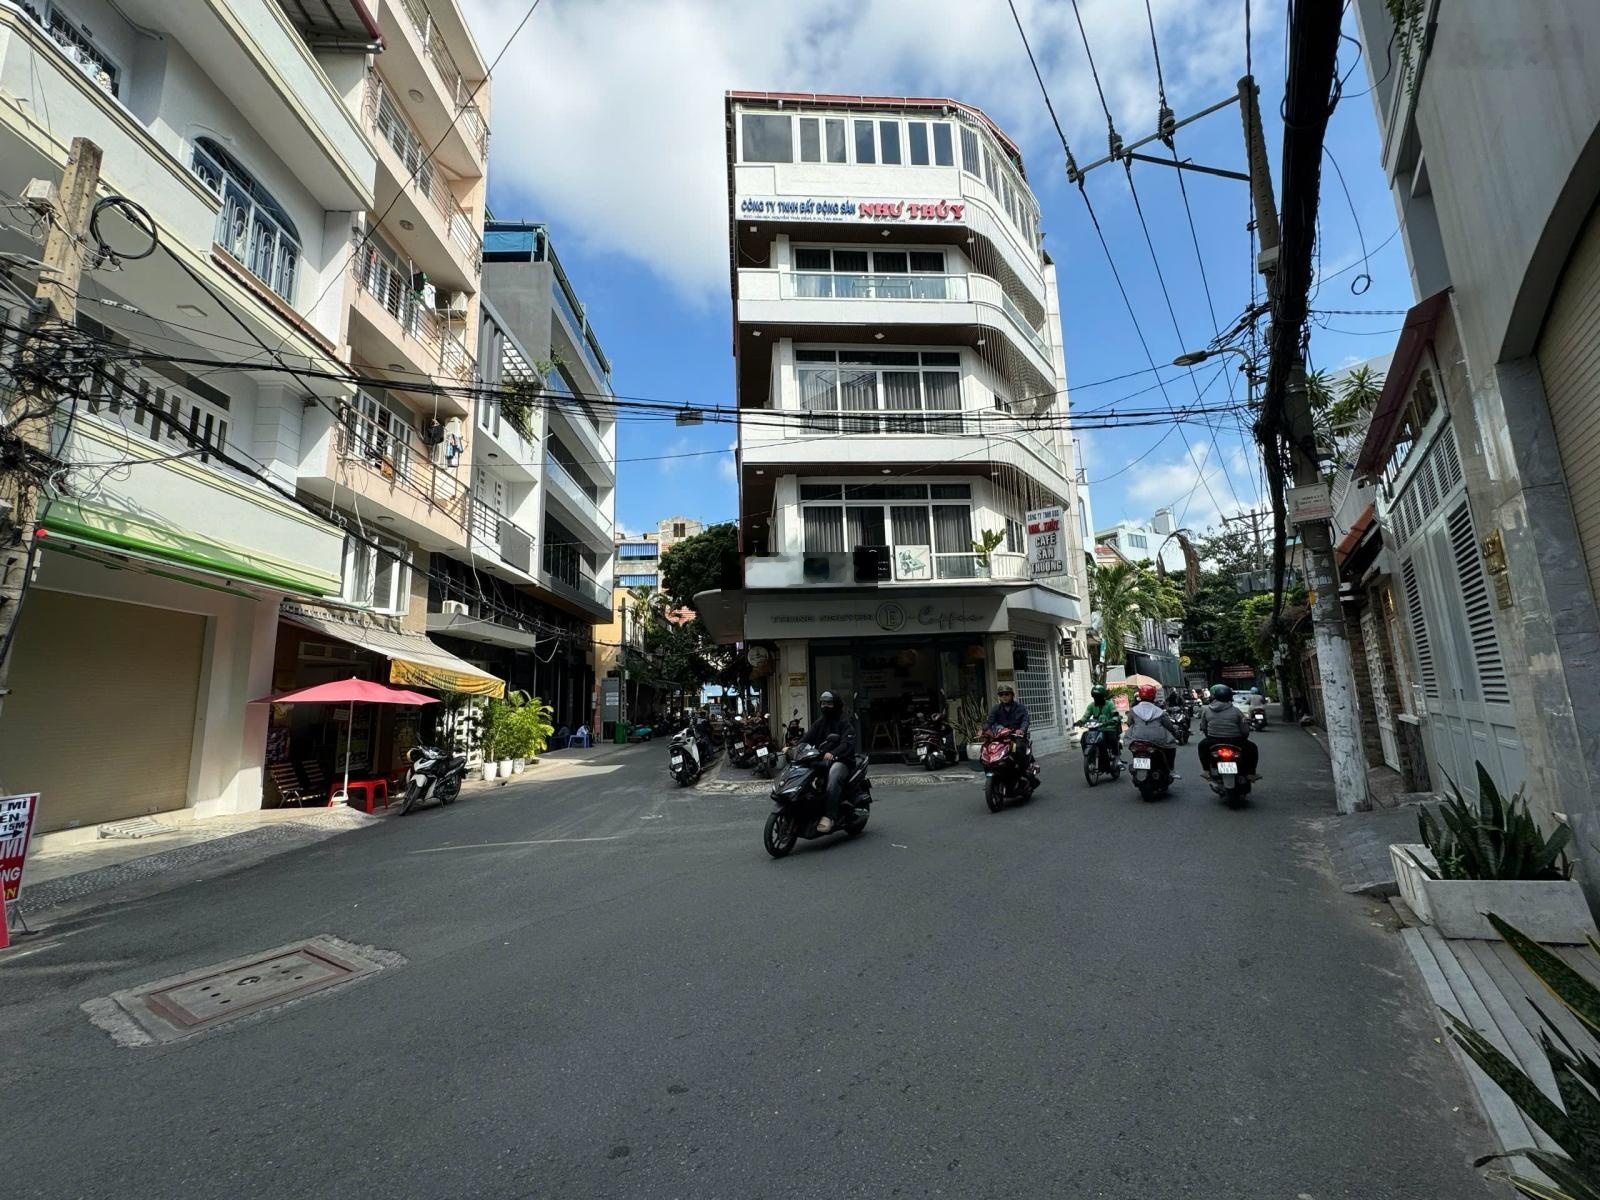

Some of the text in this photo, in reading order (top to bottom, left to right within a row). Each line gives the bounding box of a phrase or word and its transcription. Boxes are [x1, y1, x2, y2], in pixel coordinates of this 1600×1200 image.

[741, 198, 764, 212] CÔNG
[765, 200, 775, 213] TY
[778, 200, 798, 214] TNHH
[858, 200, 904, 219] NHƯ
[3, 821, 25, 831] 15M
[0, 865, 21, 882] NG
